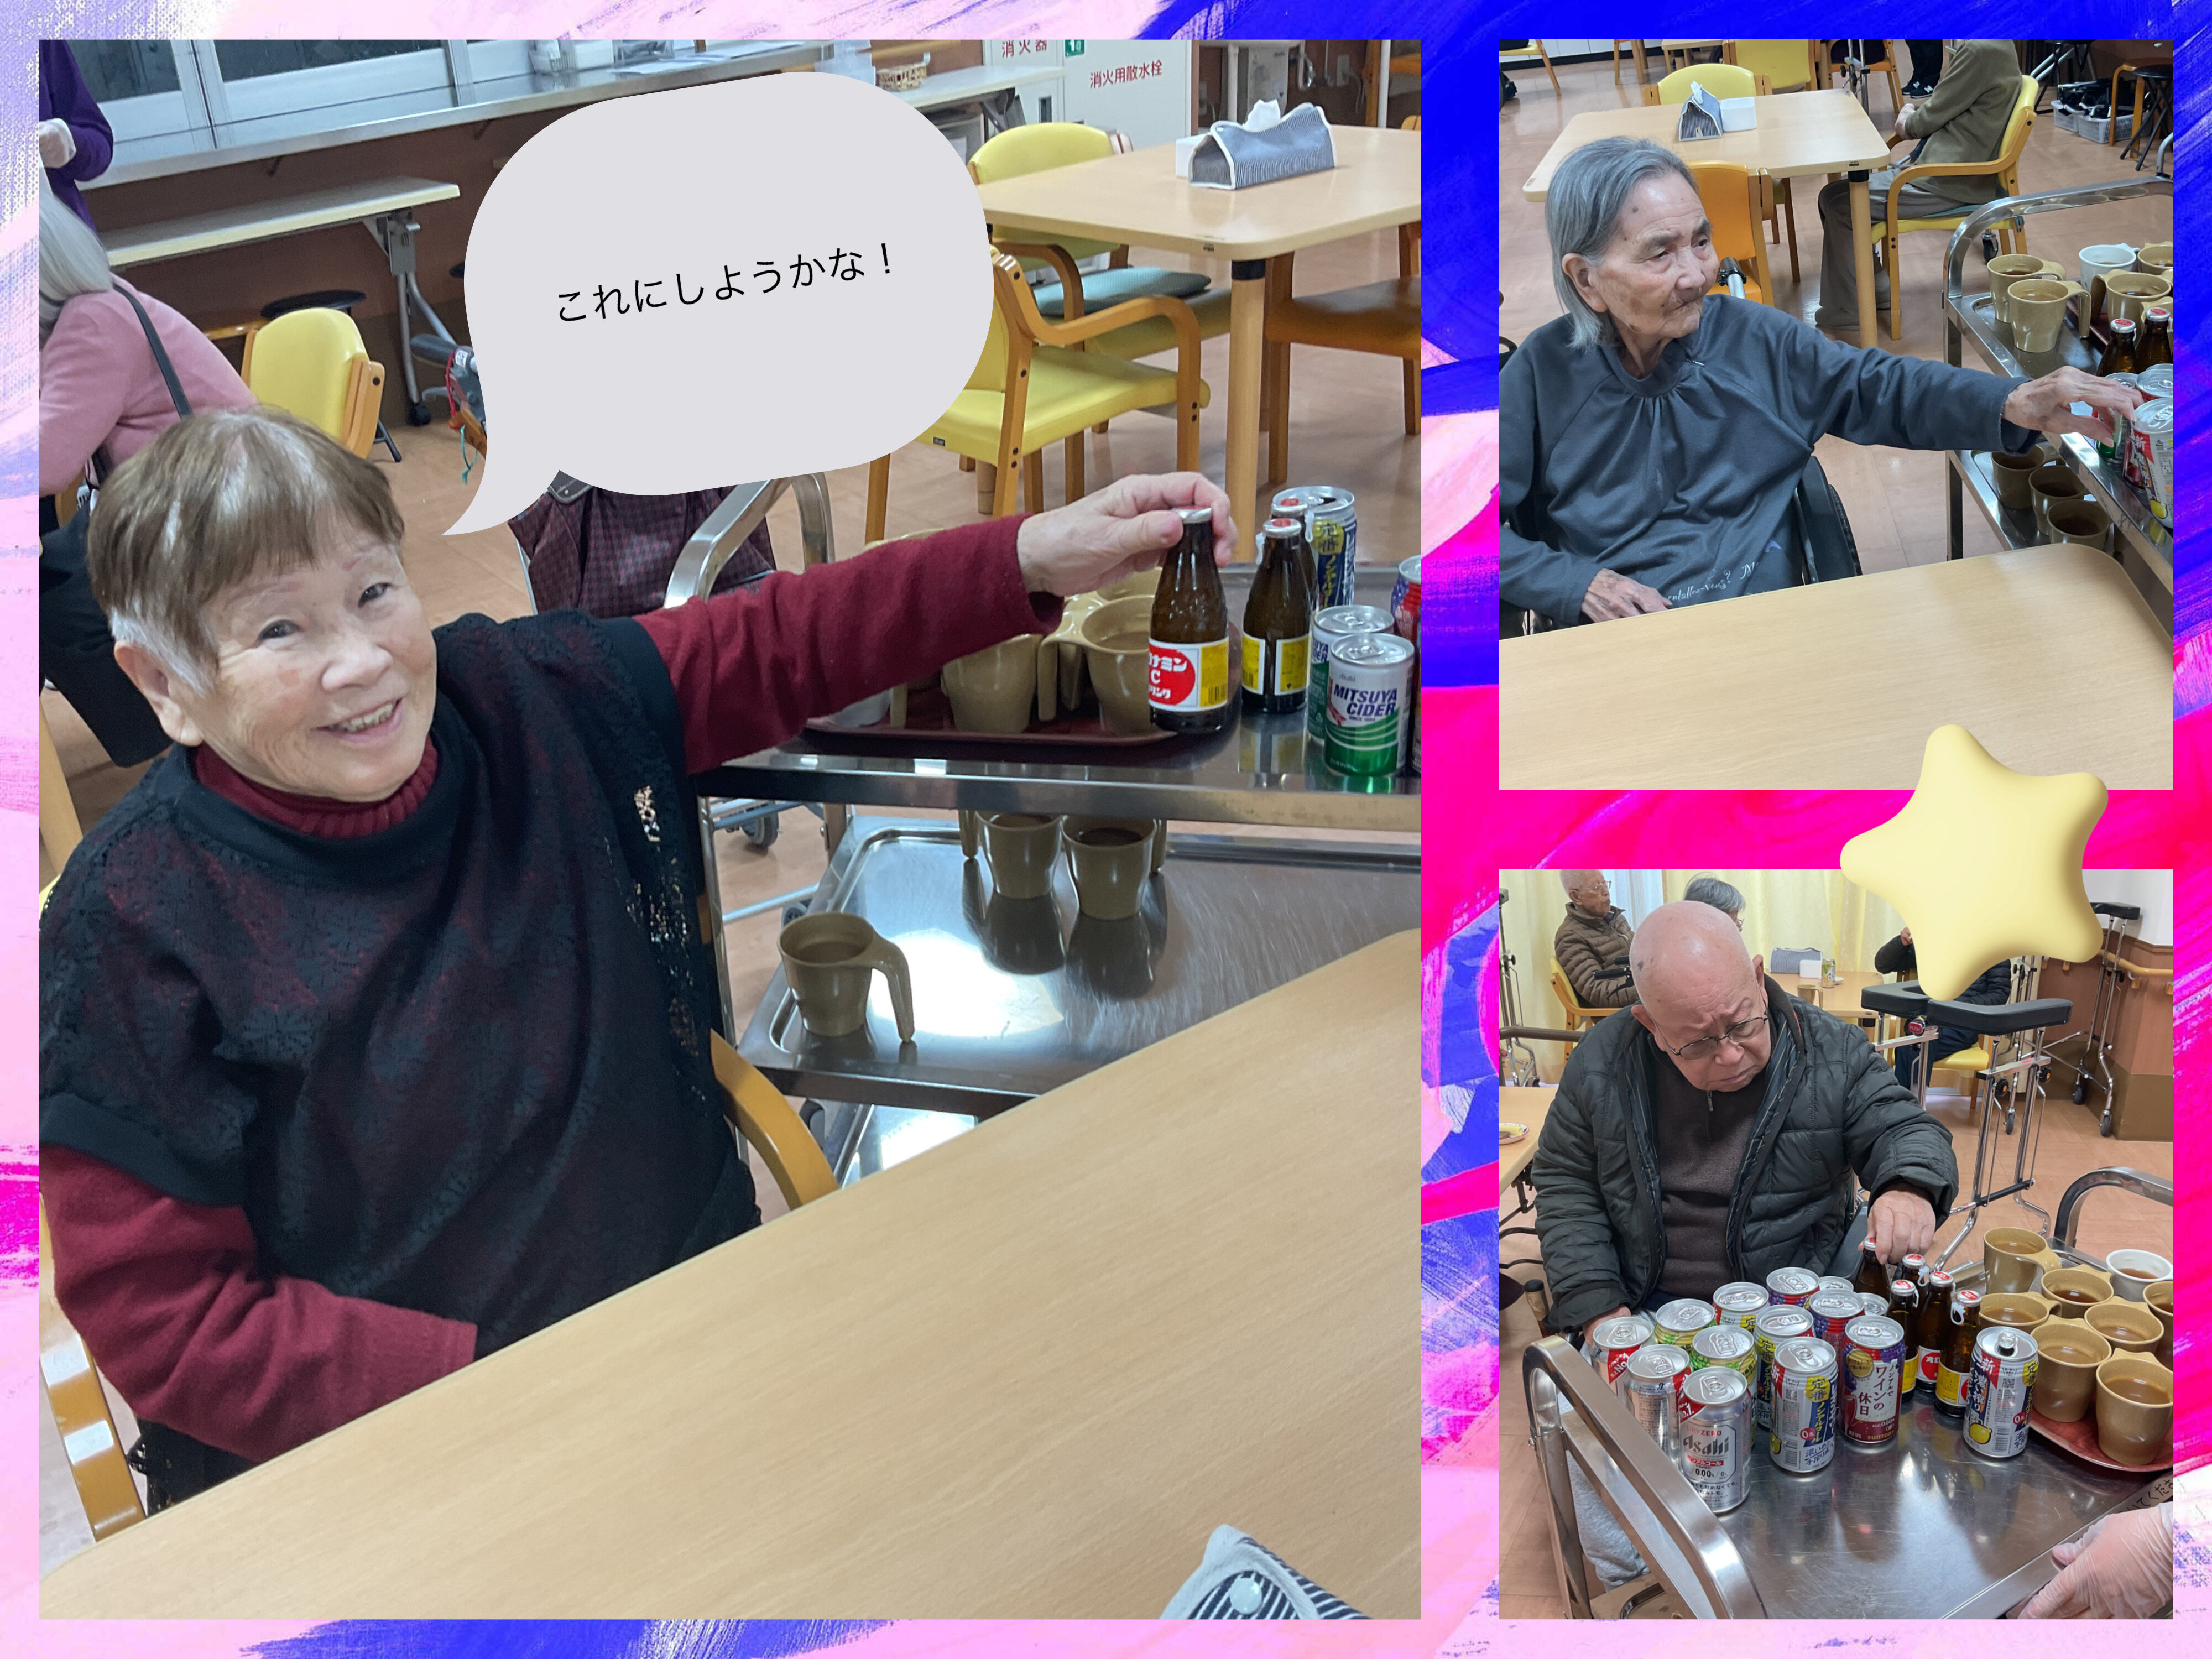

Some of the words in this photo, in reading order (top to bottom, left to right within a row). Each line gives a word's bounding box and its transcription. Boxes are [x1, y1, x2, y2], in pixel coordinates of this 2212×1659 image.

[1002, 39, 1047, 58] 消火器
[1090, 59, 1162, 89] 消火用散水栓
[1151, 669, 1160, 684] C
[1334, 684, 1397, 703] MITSUYA
[1347, 702, 1396, 717] CIDER
[1981, 1358, 1995, 1375] 新
[1811, 1379, 1827, 1401] 定番
[1874, 1366, 1887, 1411] ワインの
[1858, 1392, 1872, 1416] 休日
[1812, 1402, 1825, 1443] ノンアルコール
[1683, 1435, 1729, 1455] Asahi
